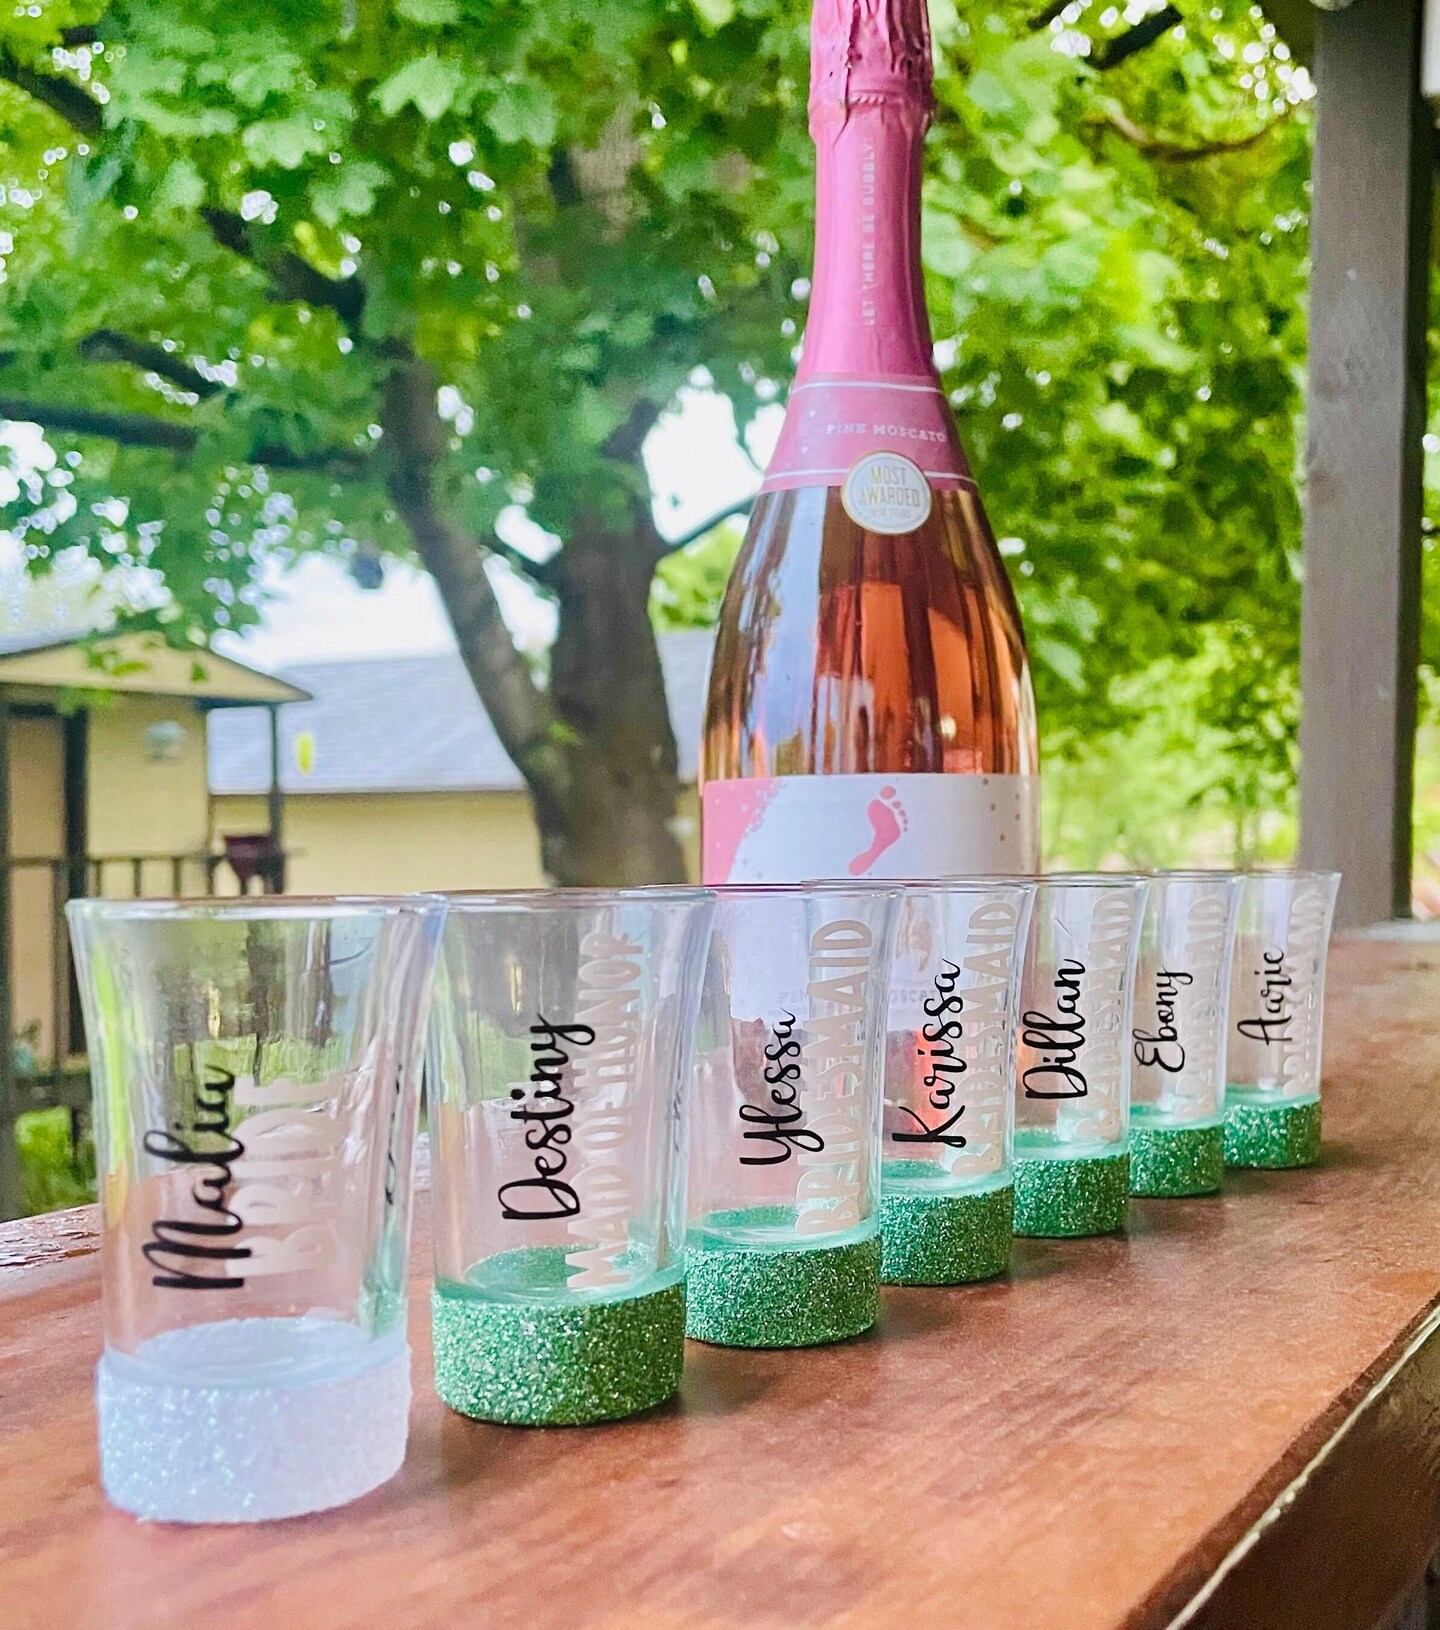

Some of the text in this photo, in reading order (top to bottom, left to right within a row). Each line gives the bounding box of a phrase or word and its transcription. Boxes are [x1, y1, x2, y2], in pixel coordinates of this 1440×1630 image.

[859, 486, 920, 508] AWARDED
[871, 465, 906, 485] MOST
[873, 424, 946, 442] MOSCATO
[565, 932, 643, 1289] MAID OF HONOR
[795, 919, 872, 1235] BRIDESMAID
[892, 958, 967, 1148] Karissa
[951, 901, 1017, 1176] BRIDESMAID
[1022, 958, 1088, 1100] Dillan
[1132, 965, 1193, 1073] Ebony
[142, 1065, 252, 1289] Malia
[498, 1013, 595, 1220] Destiny
